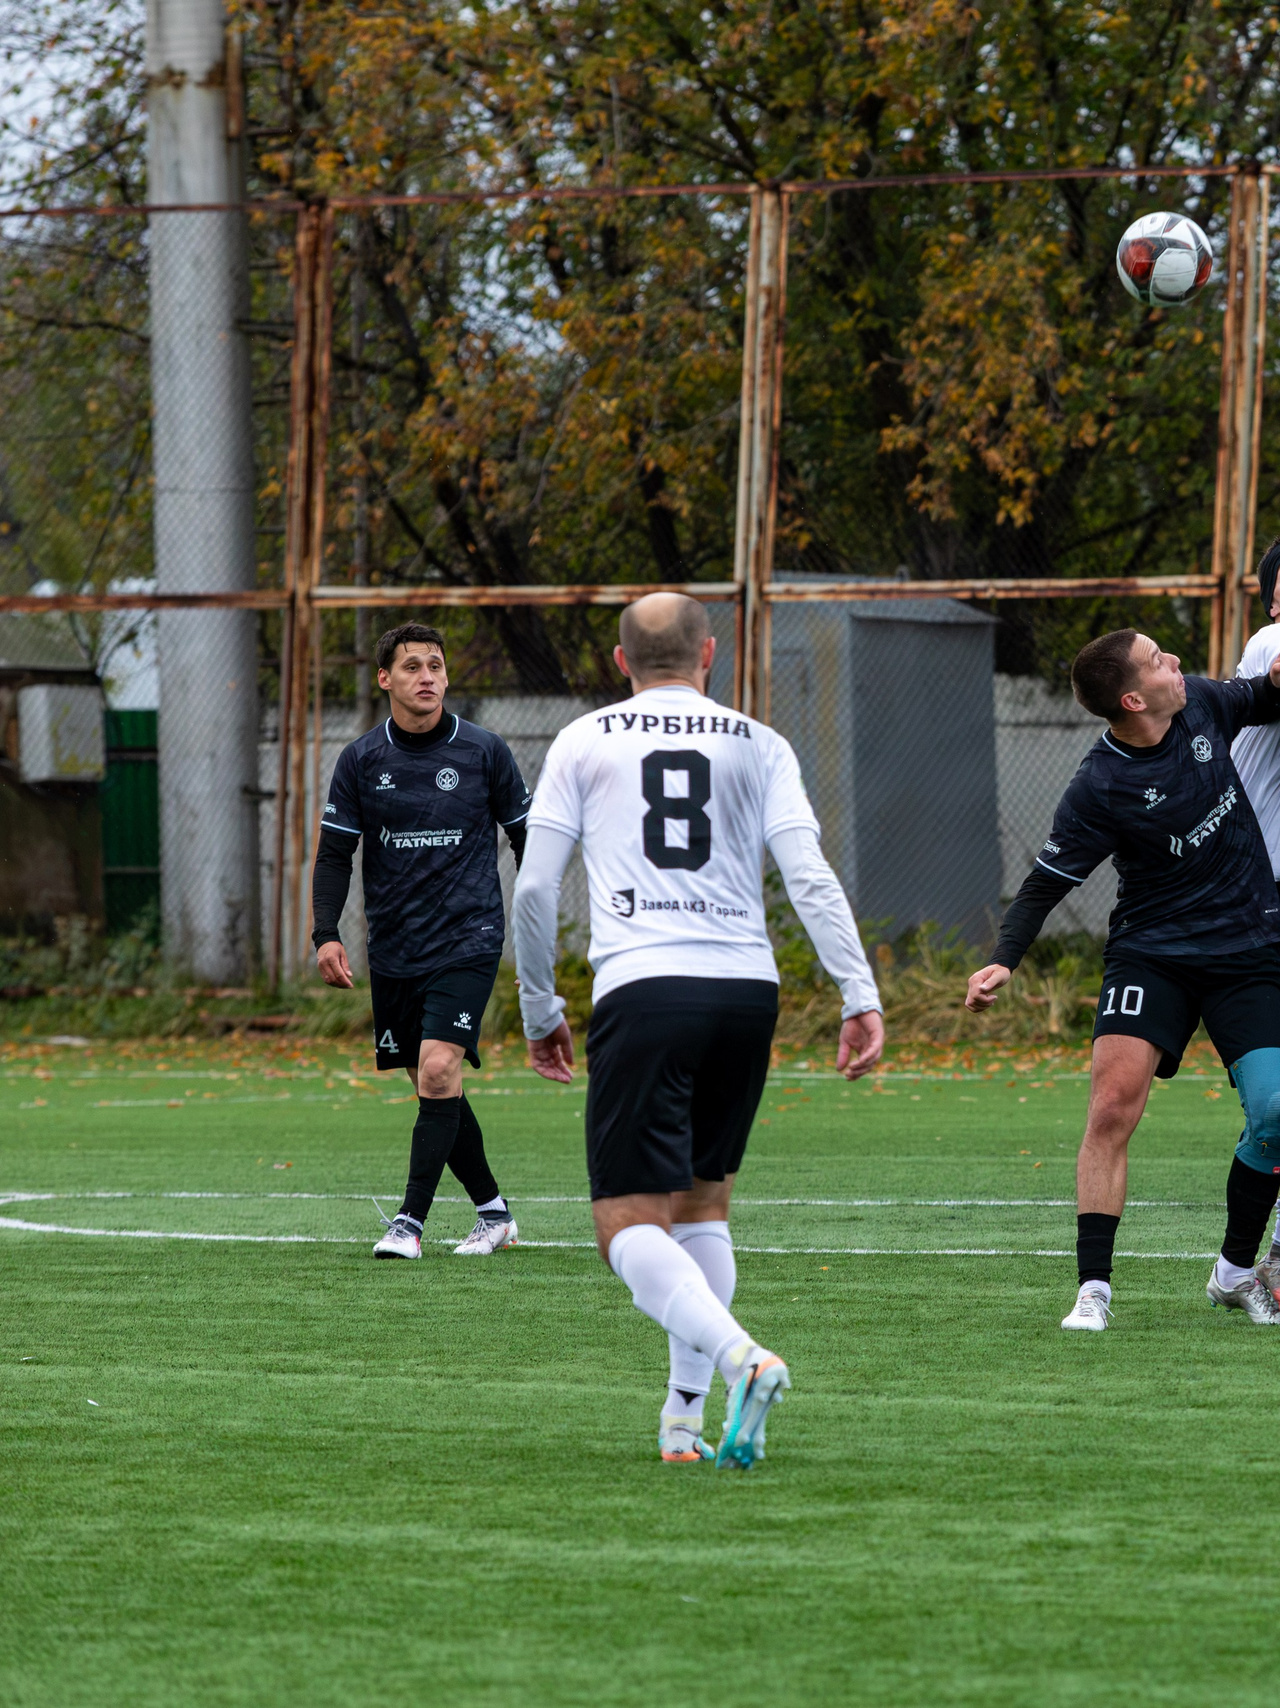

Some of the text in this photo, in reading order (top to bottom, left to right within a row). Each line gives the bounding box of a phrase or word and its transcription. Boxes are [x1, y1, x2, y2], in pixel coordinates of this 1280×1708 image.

[597, 712, 752, 740] ТУРБИНА
[376, 783, 396, 791] KELME
[641, 749, 711, 872] 8
[1145, 793, 1168, 810] KELME
[392, 835, 463, 849] TATNEFT
[639, 899, 680, 912] Завод
[709, 901, 749, 919] Гарант
[1102, 985, 1144, 1016] 10
[453, 1021, 472, 1031] KELME
